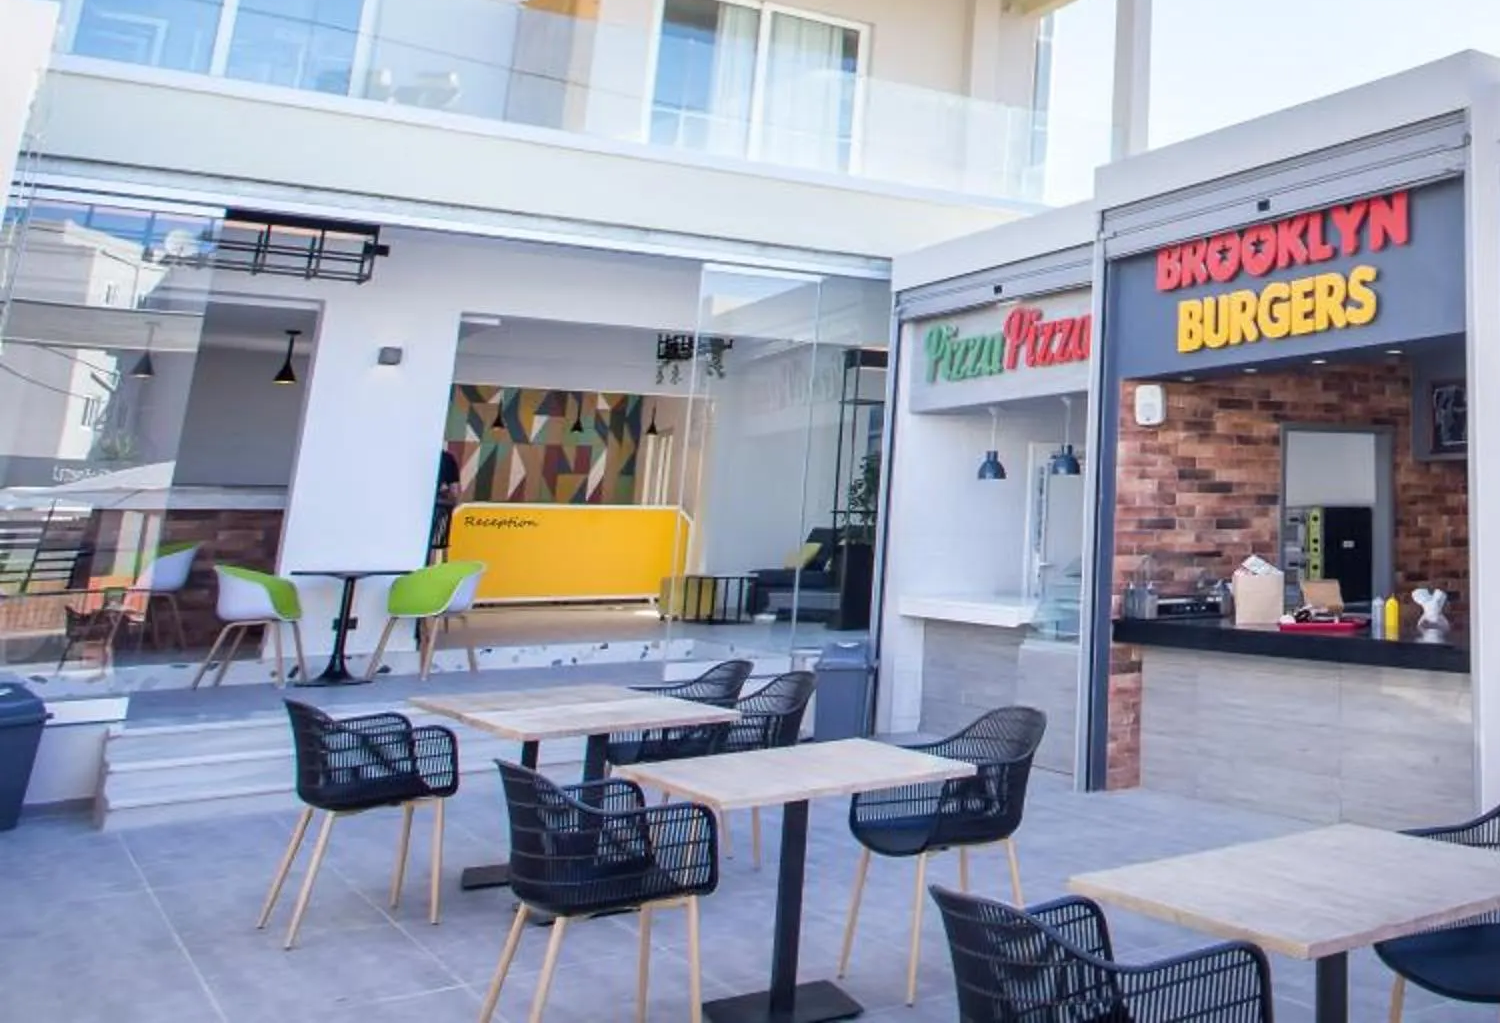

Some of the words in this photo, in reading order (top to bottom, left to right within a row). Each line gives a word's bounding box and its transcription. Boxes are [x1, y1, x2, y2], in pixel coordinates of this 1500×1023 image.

[1156, 191, 1408, 292] BROOKLYN
[1177, 264, 1377, 353] BURGERS
[464, 516, 538, 529] Reception
